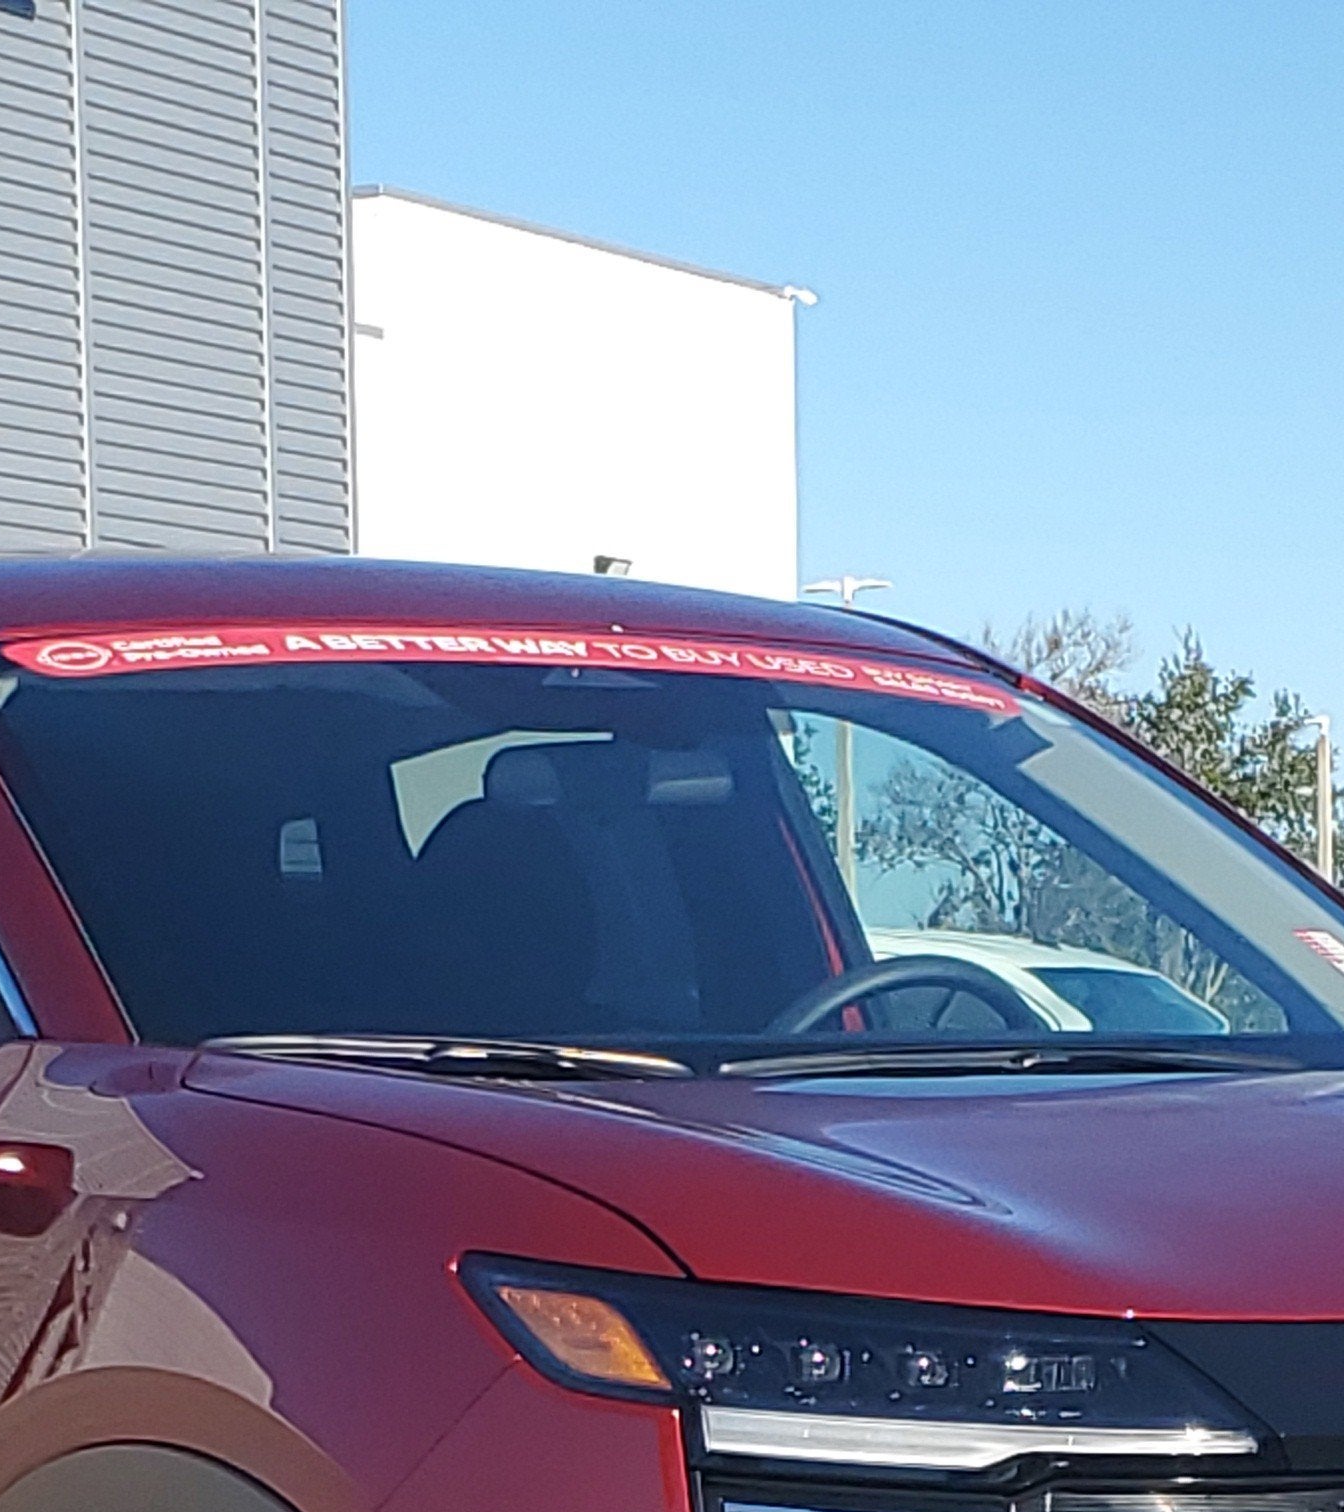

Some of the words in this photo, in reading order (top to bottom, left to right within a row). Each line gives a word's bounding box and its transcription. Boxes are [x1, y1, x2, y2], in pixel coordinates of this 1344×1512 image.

[284, 635, 323, 651] A
[318, 634, 496, 653] BETTER
[491, 637, 589, 657] WAY
[592, 641, 659, 661] TO
[659, 645, 741, 667] BUY
[745, 653, 855, 680] USED
